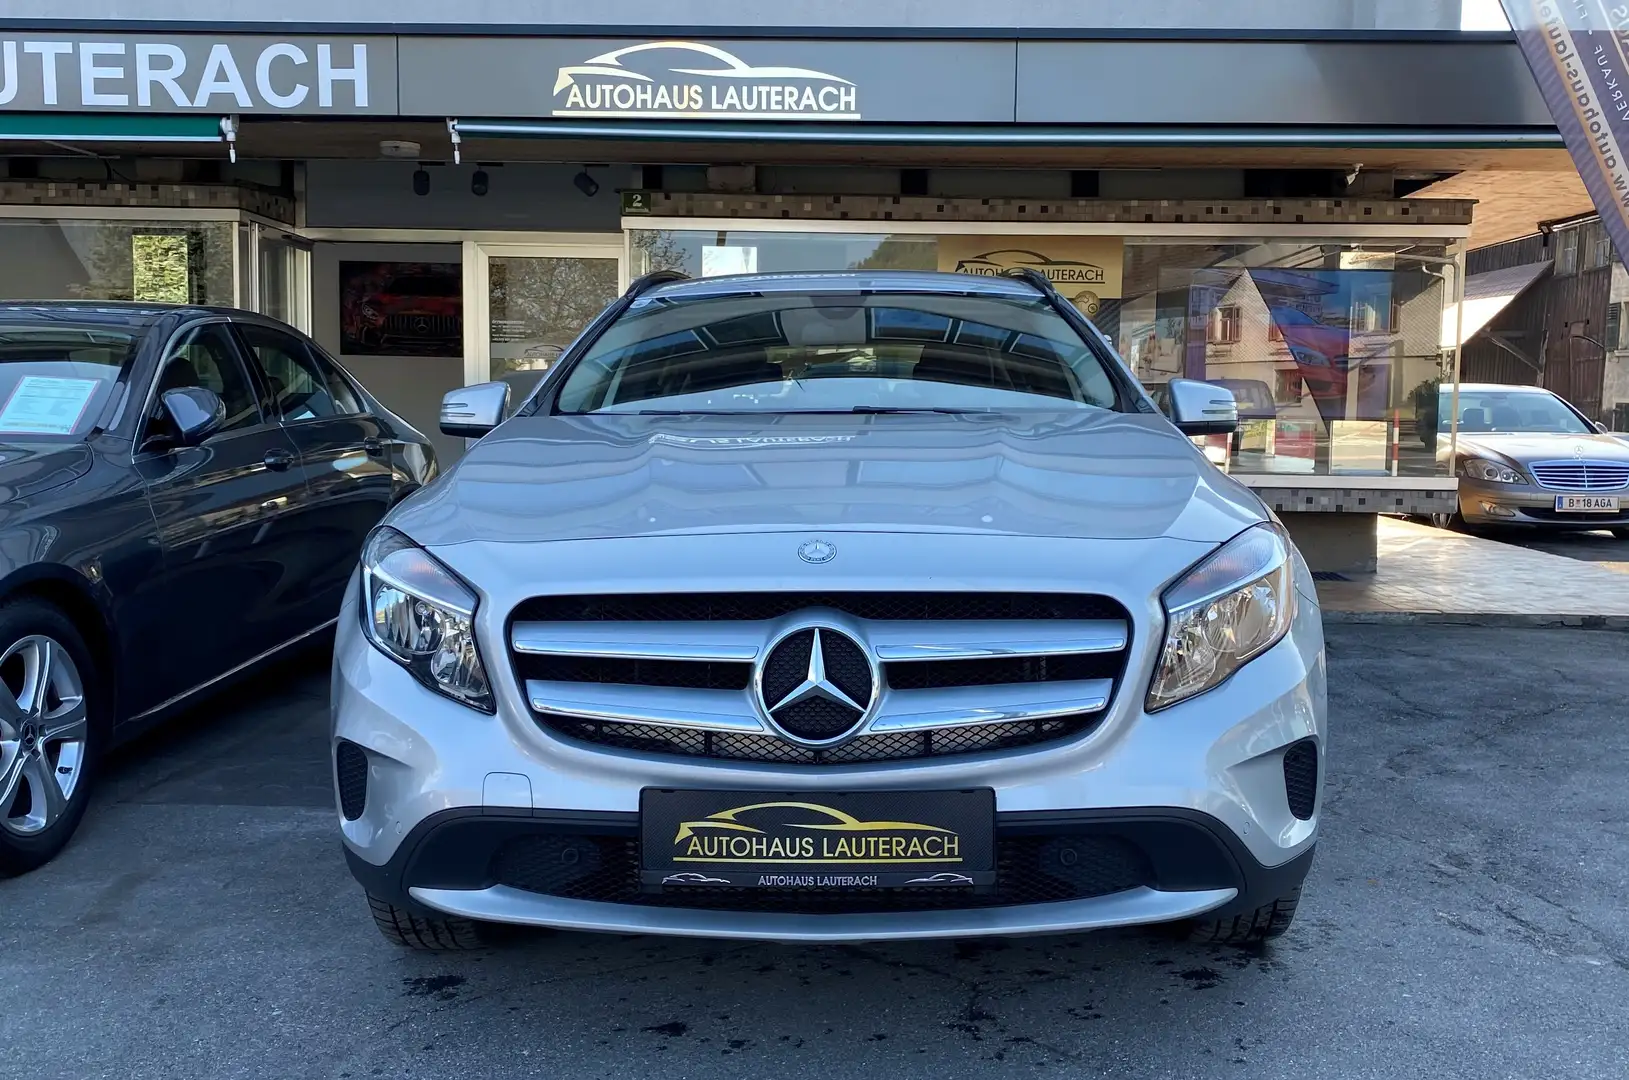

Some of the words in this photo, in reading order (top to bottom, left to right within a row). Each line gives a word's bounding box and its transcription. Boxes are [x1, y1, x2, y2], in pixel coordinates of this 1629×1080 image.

[566, 84, 703, 109] AUTOHAUS
[711, 86, 856, 112] LAUTERACH
[632, 194, 643, 207] 2
[1040, 268, 1104, 281] AUTERACH
[1568, 498, 1575, 508] B
[1582, 498, 1592, 508] 18
[1594, 498, 1612, 508] AGA
[687, 836, 814, 858] AUTOHAUS
[823, 836, 960, 858] LAUTERACH
[758, 875, 815, 887] AUTOHAUS
[816, 875, 878, 887] LAUTERACH
